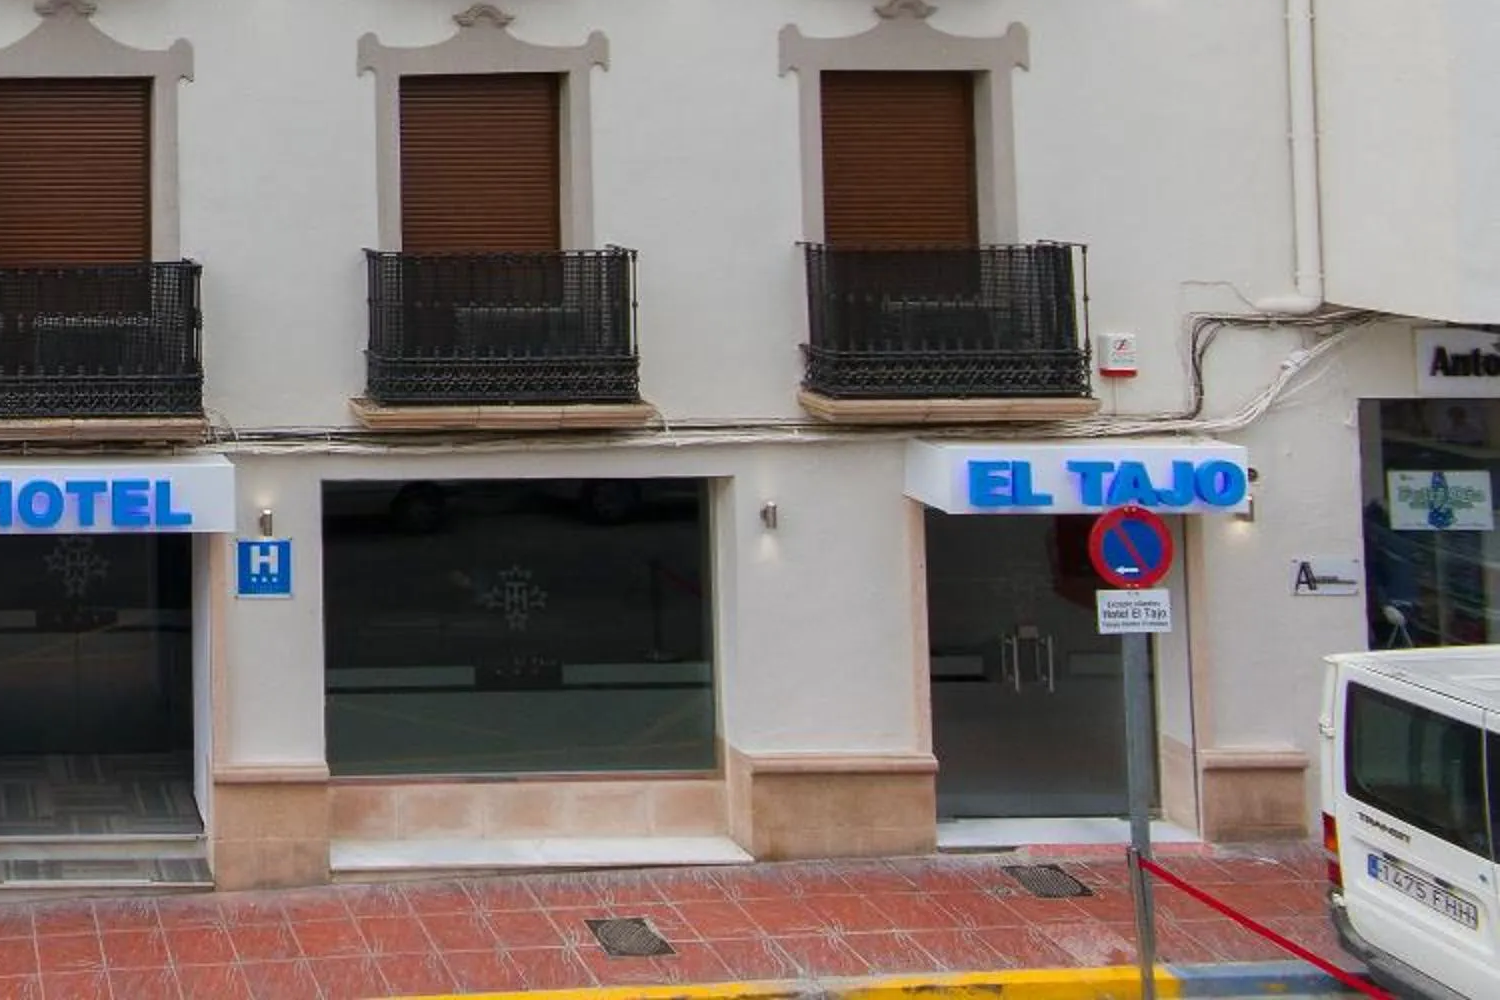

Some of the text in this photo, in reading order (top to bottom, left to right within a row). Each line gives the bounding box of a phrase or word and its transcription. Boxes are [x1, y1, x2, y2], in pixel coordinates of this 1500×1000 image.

[967, 460, 1247, 509] EL TAJO
[251, 544, 279, 574] H
[1103, 609, 1128, 619] Hotel
[1144, 608, 1167, 620] Tajo
[1357, 811, 1412, 844] TRANSIT
[1383, 864, 1427, 900] 1475
